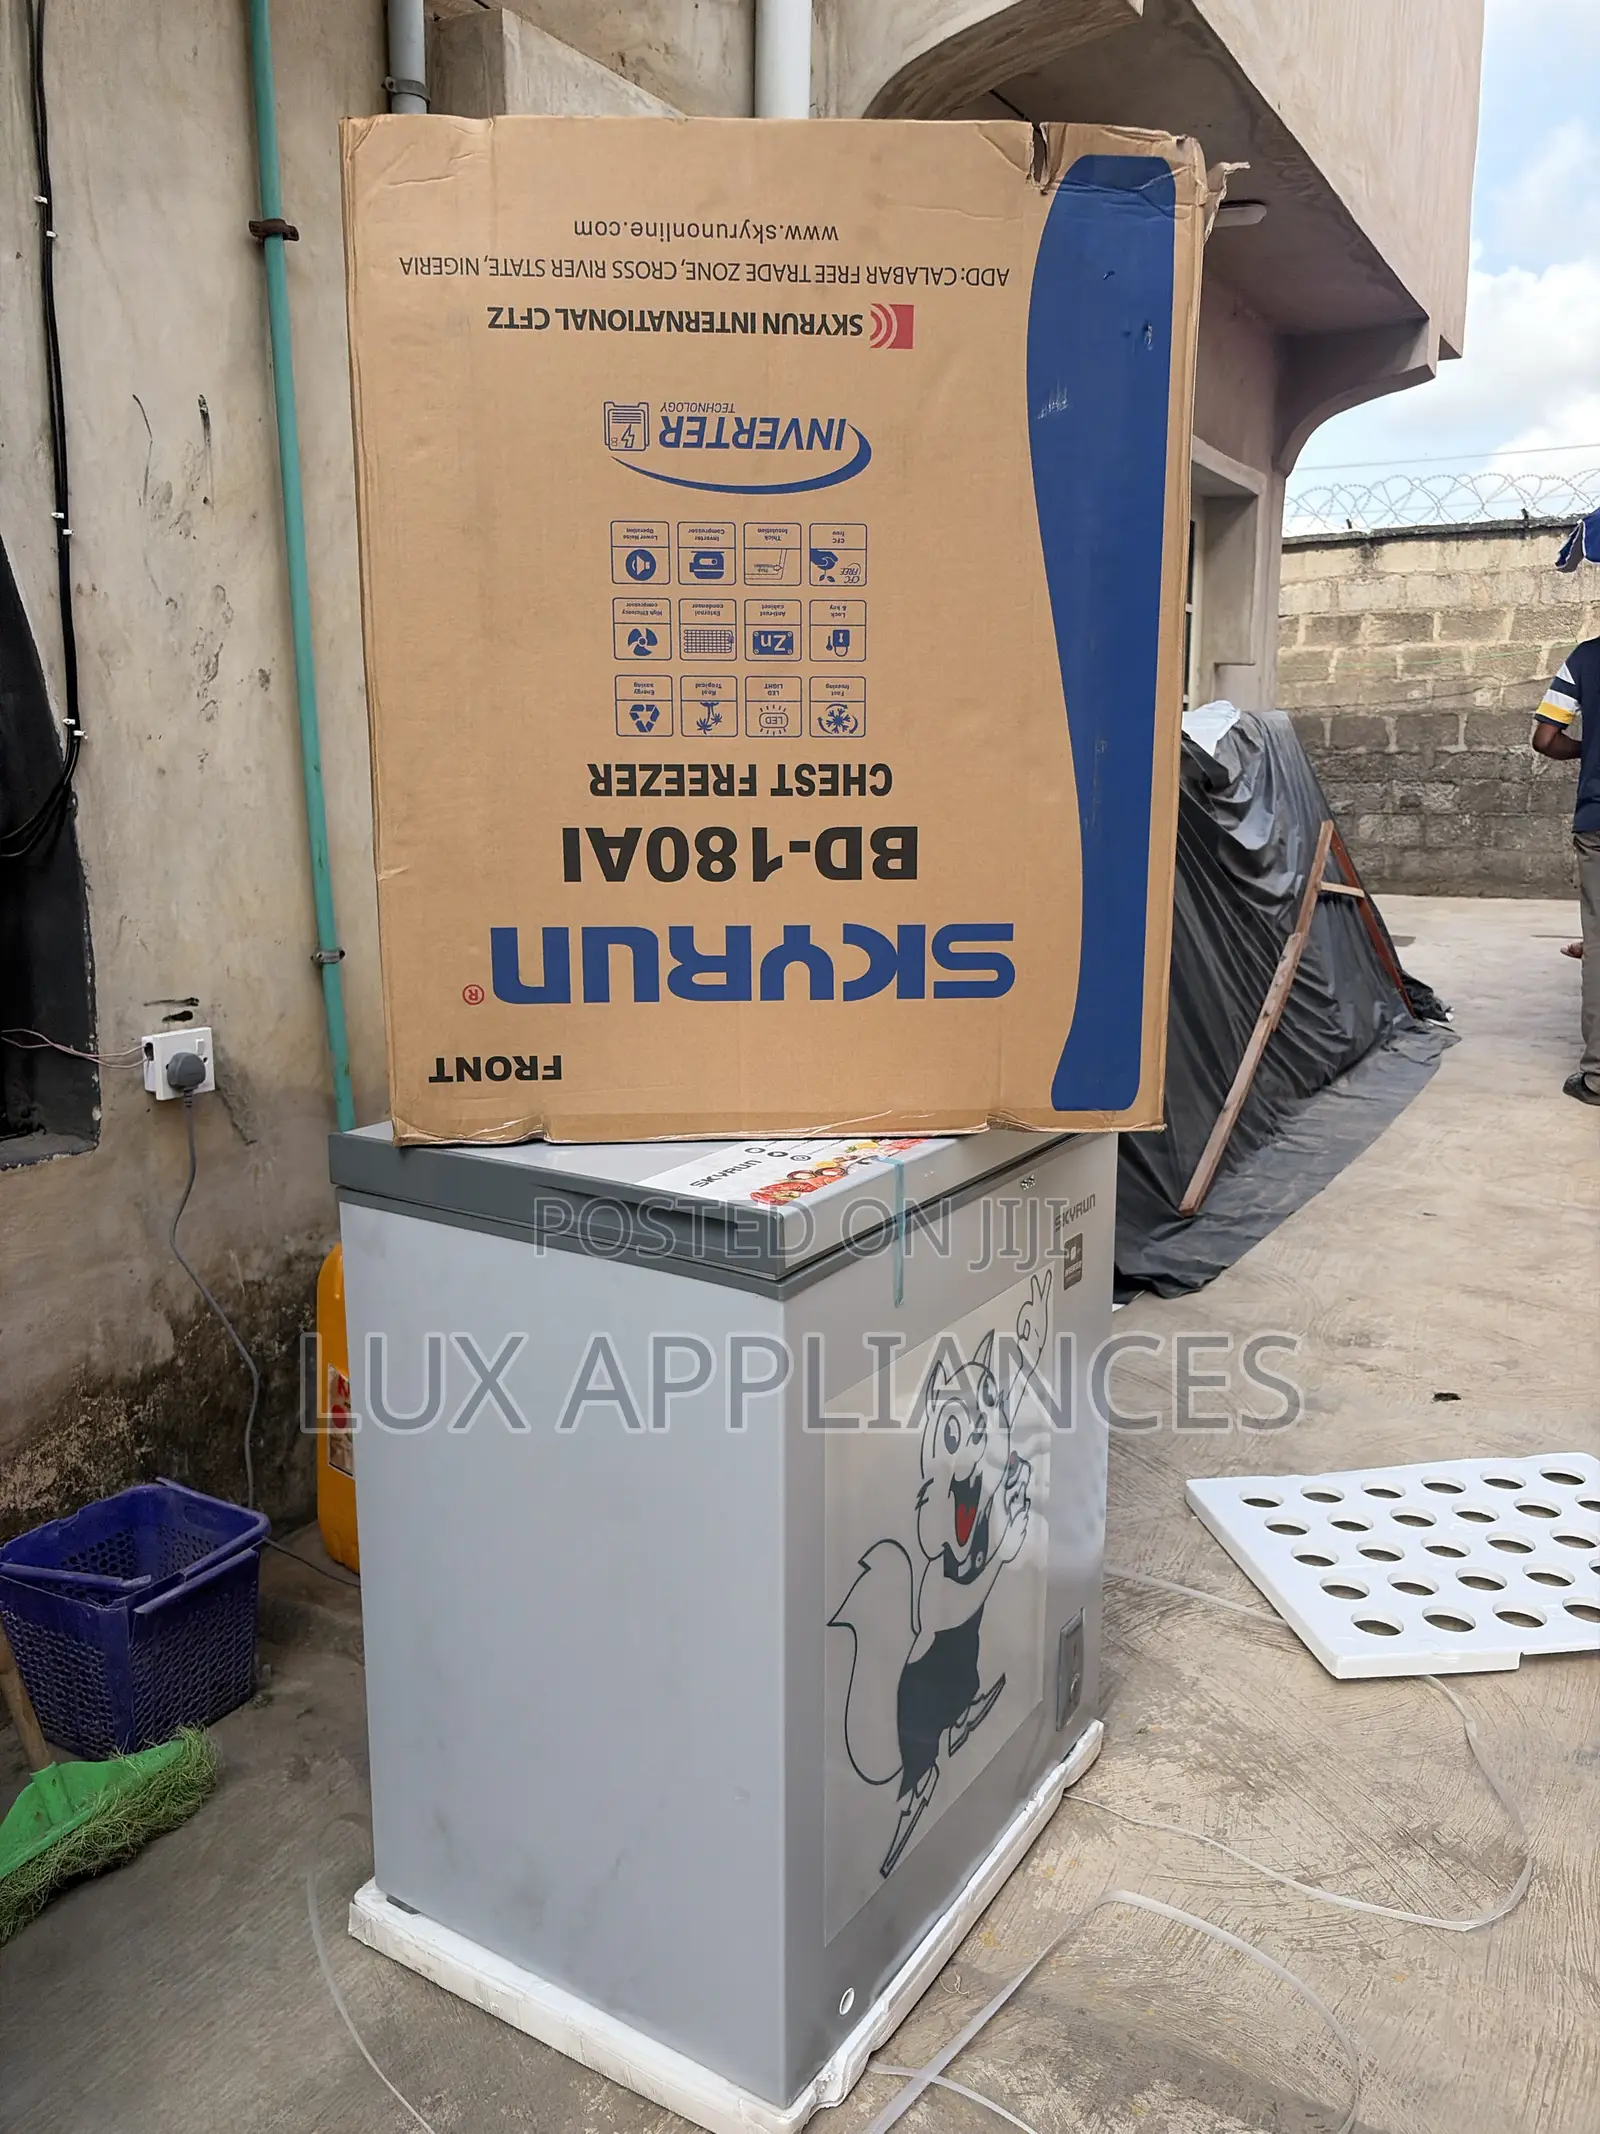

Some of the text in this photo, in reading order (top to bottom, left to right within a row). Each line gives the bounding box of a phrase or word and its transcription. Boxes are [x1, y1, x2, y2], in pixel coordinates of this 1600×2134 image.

[573, 219, 839, 245] www.skyrunonline.com
[399, 256, 1011, 287] ADD: CALABAR FREE TRADE ZONE, CROSS RIVER STATE, NIGERIA
[487, 306, 863, 336] SKYRUN INTERNATIONAL CFTZ
[660, 402, 735, 414] TECHNOLOGY
[658, 414, 847, 452] INVERTER
[840, 567, 859, 575] FREE
[844, 576, 860, 584] CFC
[760, 634, 787, 651] Zn
[765, 716, 783, 724] LED
[587, 762, 893, 798] CHEST FREEZER
[561, 825, 919, 883] BD-180AI
[490, 922, 1016, 1005] SKYRUN
[428, 1055, 563, 1083] FRONT
[688, 1158, 763, 1188] SKYRUN
